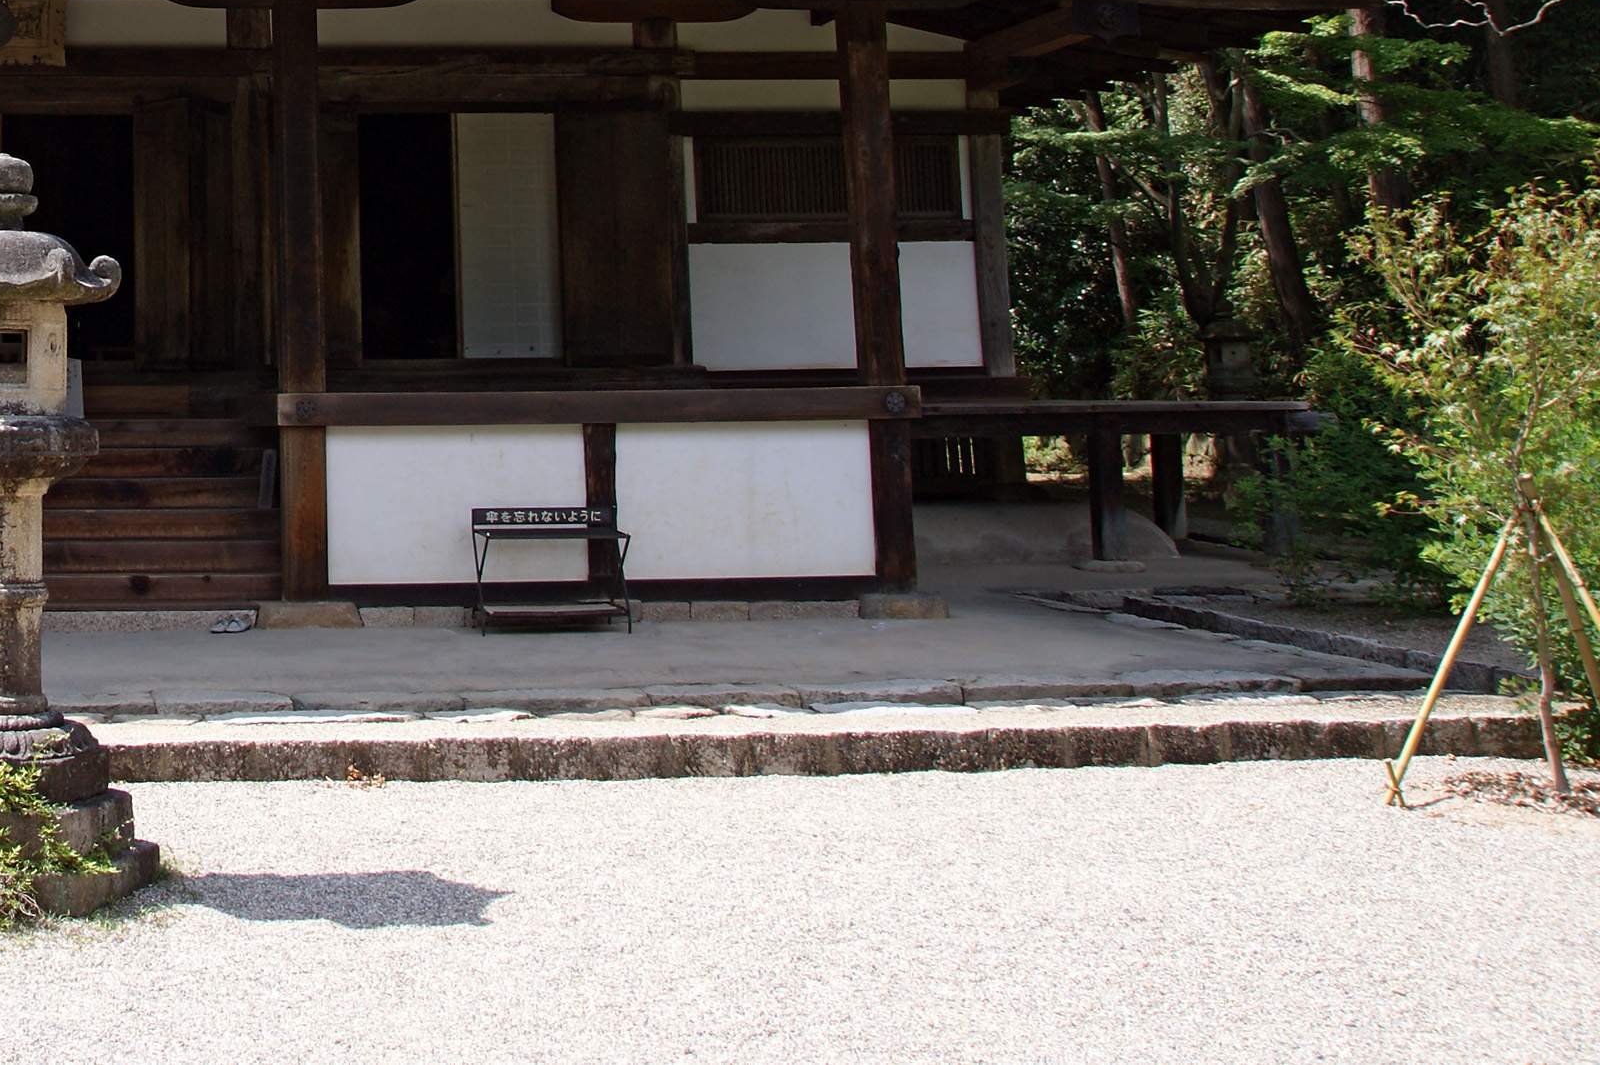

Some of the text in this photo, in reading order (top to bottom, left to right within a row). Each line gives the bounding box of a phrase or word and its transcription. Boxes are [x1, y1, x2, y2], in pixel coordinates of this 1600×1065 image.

[486, 510, 601, 523] 傘を忘れないように
